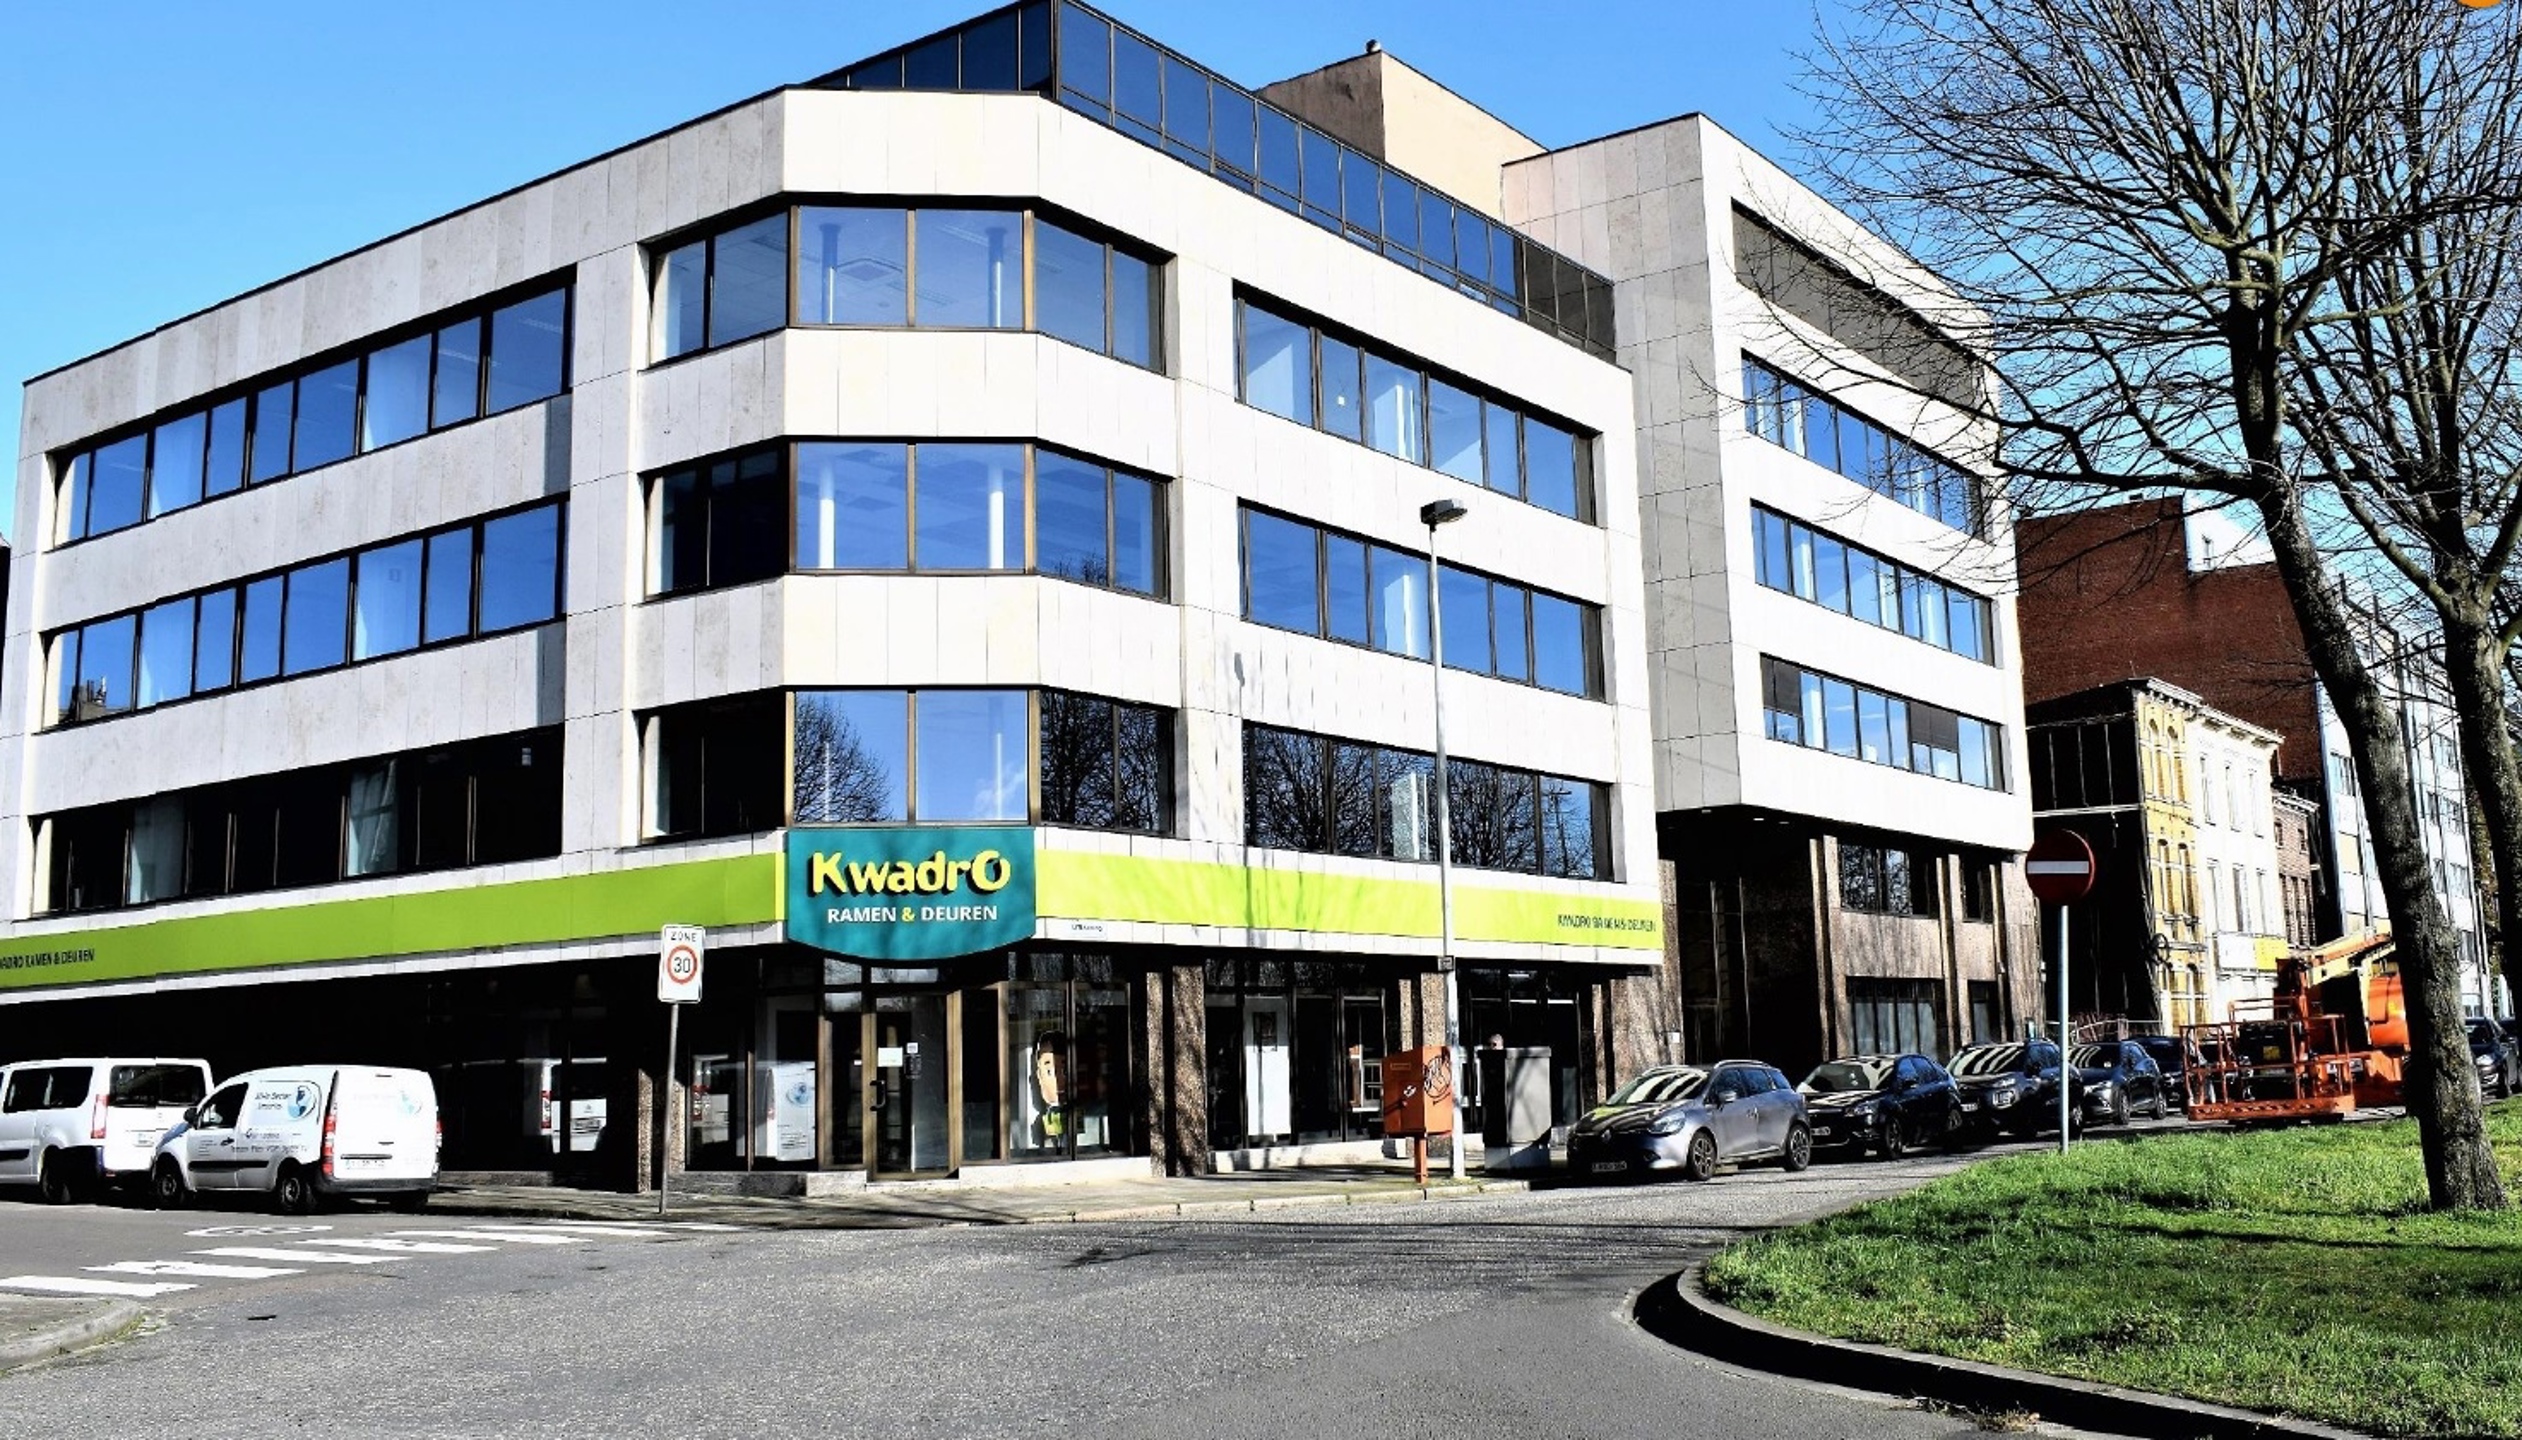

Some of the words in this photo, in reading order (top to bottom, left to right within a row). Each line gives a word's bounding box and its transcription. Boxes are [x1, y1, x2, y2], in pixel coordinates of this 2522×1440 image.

[828, 907, 896, 923] RAMEN
[902, 907, 915, 922] &
[921, 906, 997, 921] DEUREN
[671, 931, 697, 942] ZONE
[62, 948, 95, 964] DEUREN
[674, 957, 691, 973] 30
